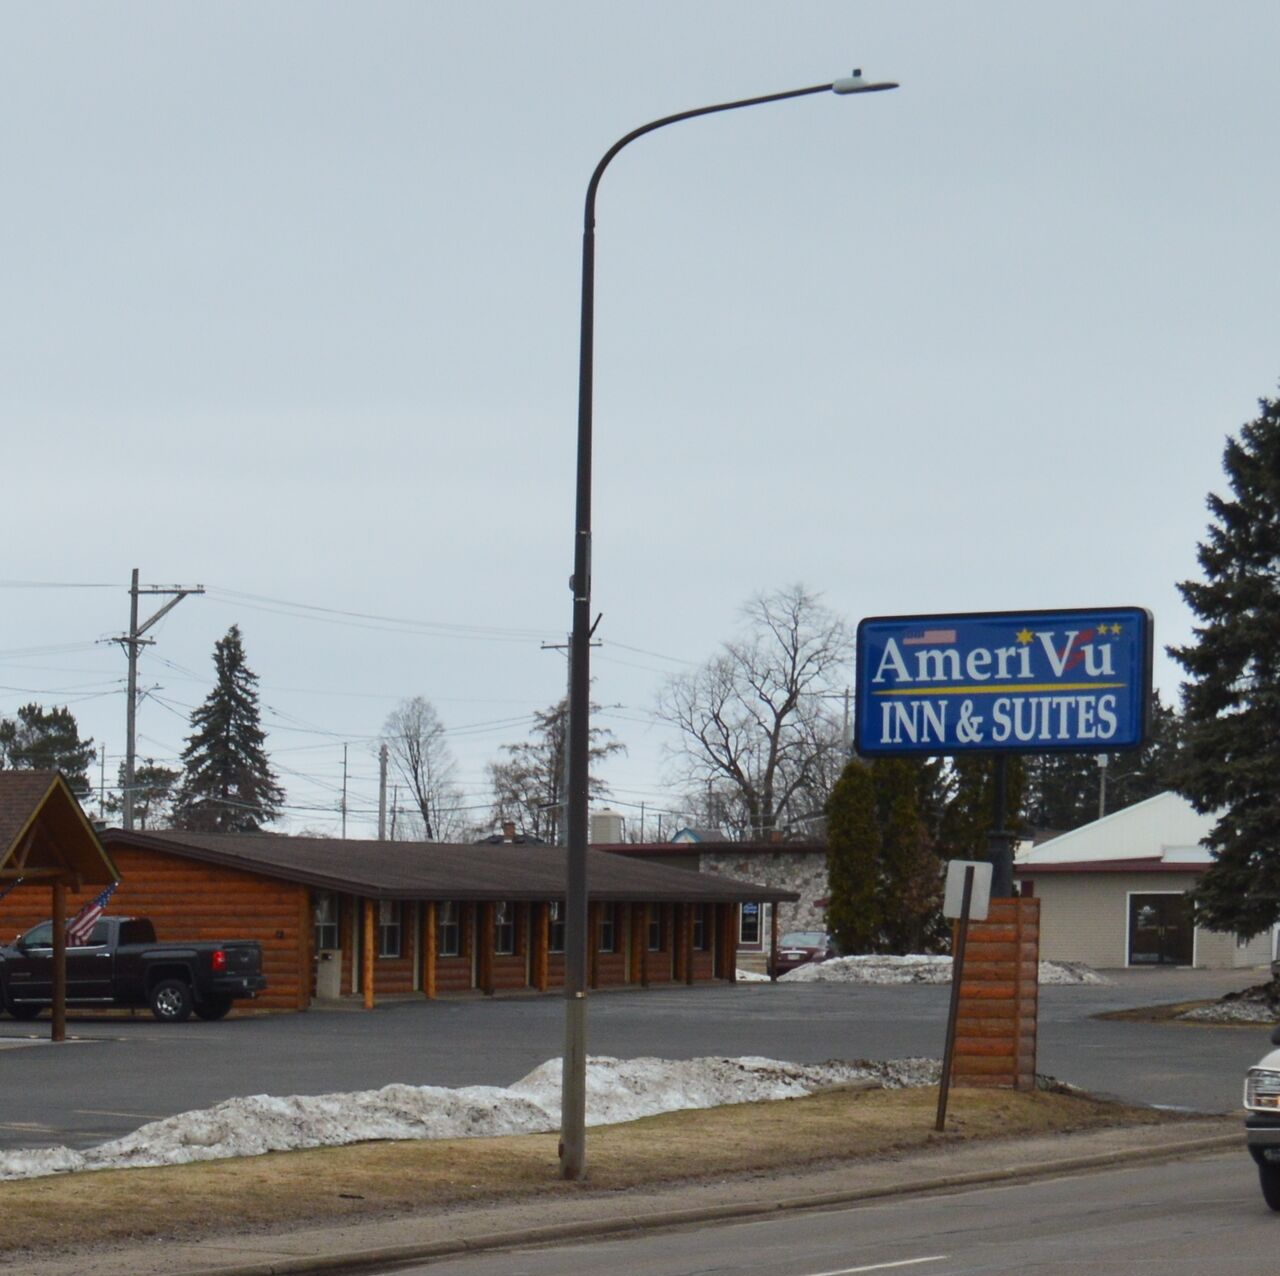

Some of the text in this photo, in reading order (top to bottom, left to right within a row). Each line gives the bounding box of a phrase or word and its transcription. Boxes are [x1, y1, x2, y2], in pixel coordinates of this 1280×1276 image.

[872, 629, 1115, 683] AmeriVu
[880, 695, 1117, 743] INN & SUITES
